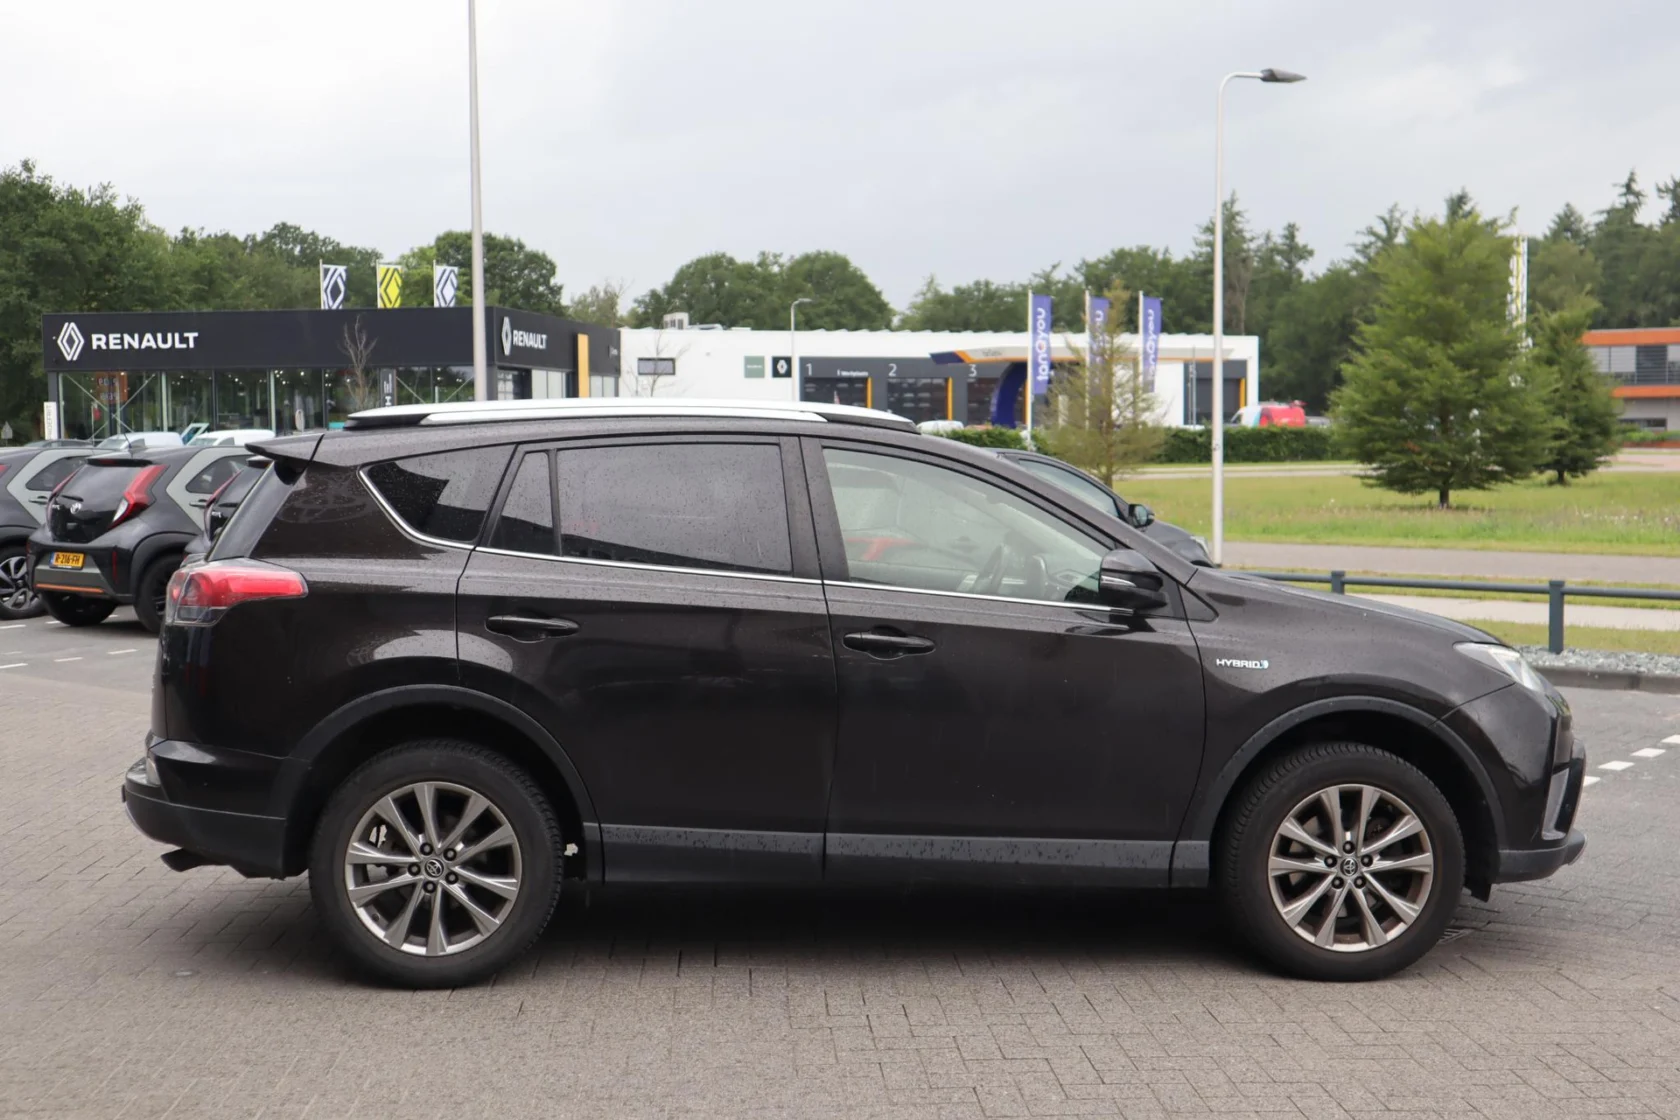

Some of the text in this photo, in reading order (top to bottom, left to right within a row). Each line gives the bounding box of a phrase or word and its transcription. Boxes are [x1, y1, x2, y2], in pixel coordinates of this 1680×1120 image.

[91, 332, 199, 350] RENAULT
[512, 329, 548, 350] RENAULT
[805, 363, 813, 375] 1
[888, 363, 897, 376] 2
[968, 364, 977, 376] 3
[1216, 658, 1262, 669] HYBRID
